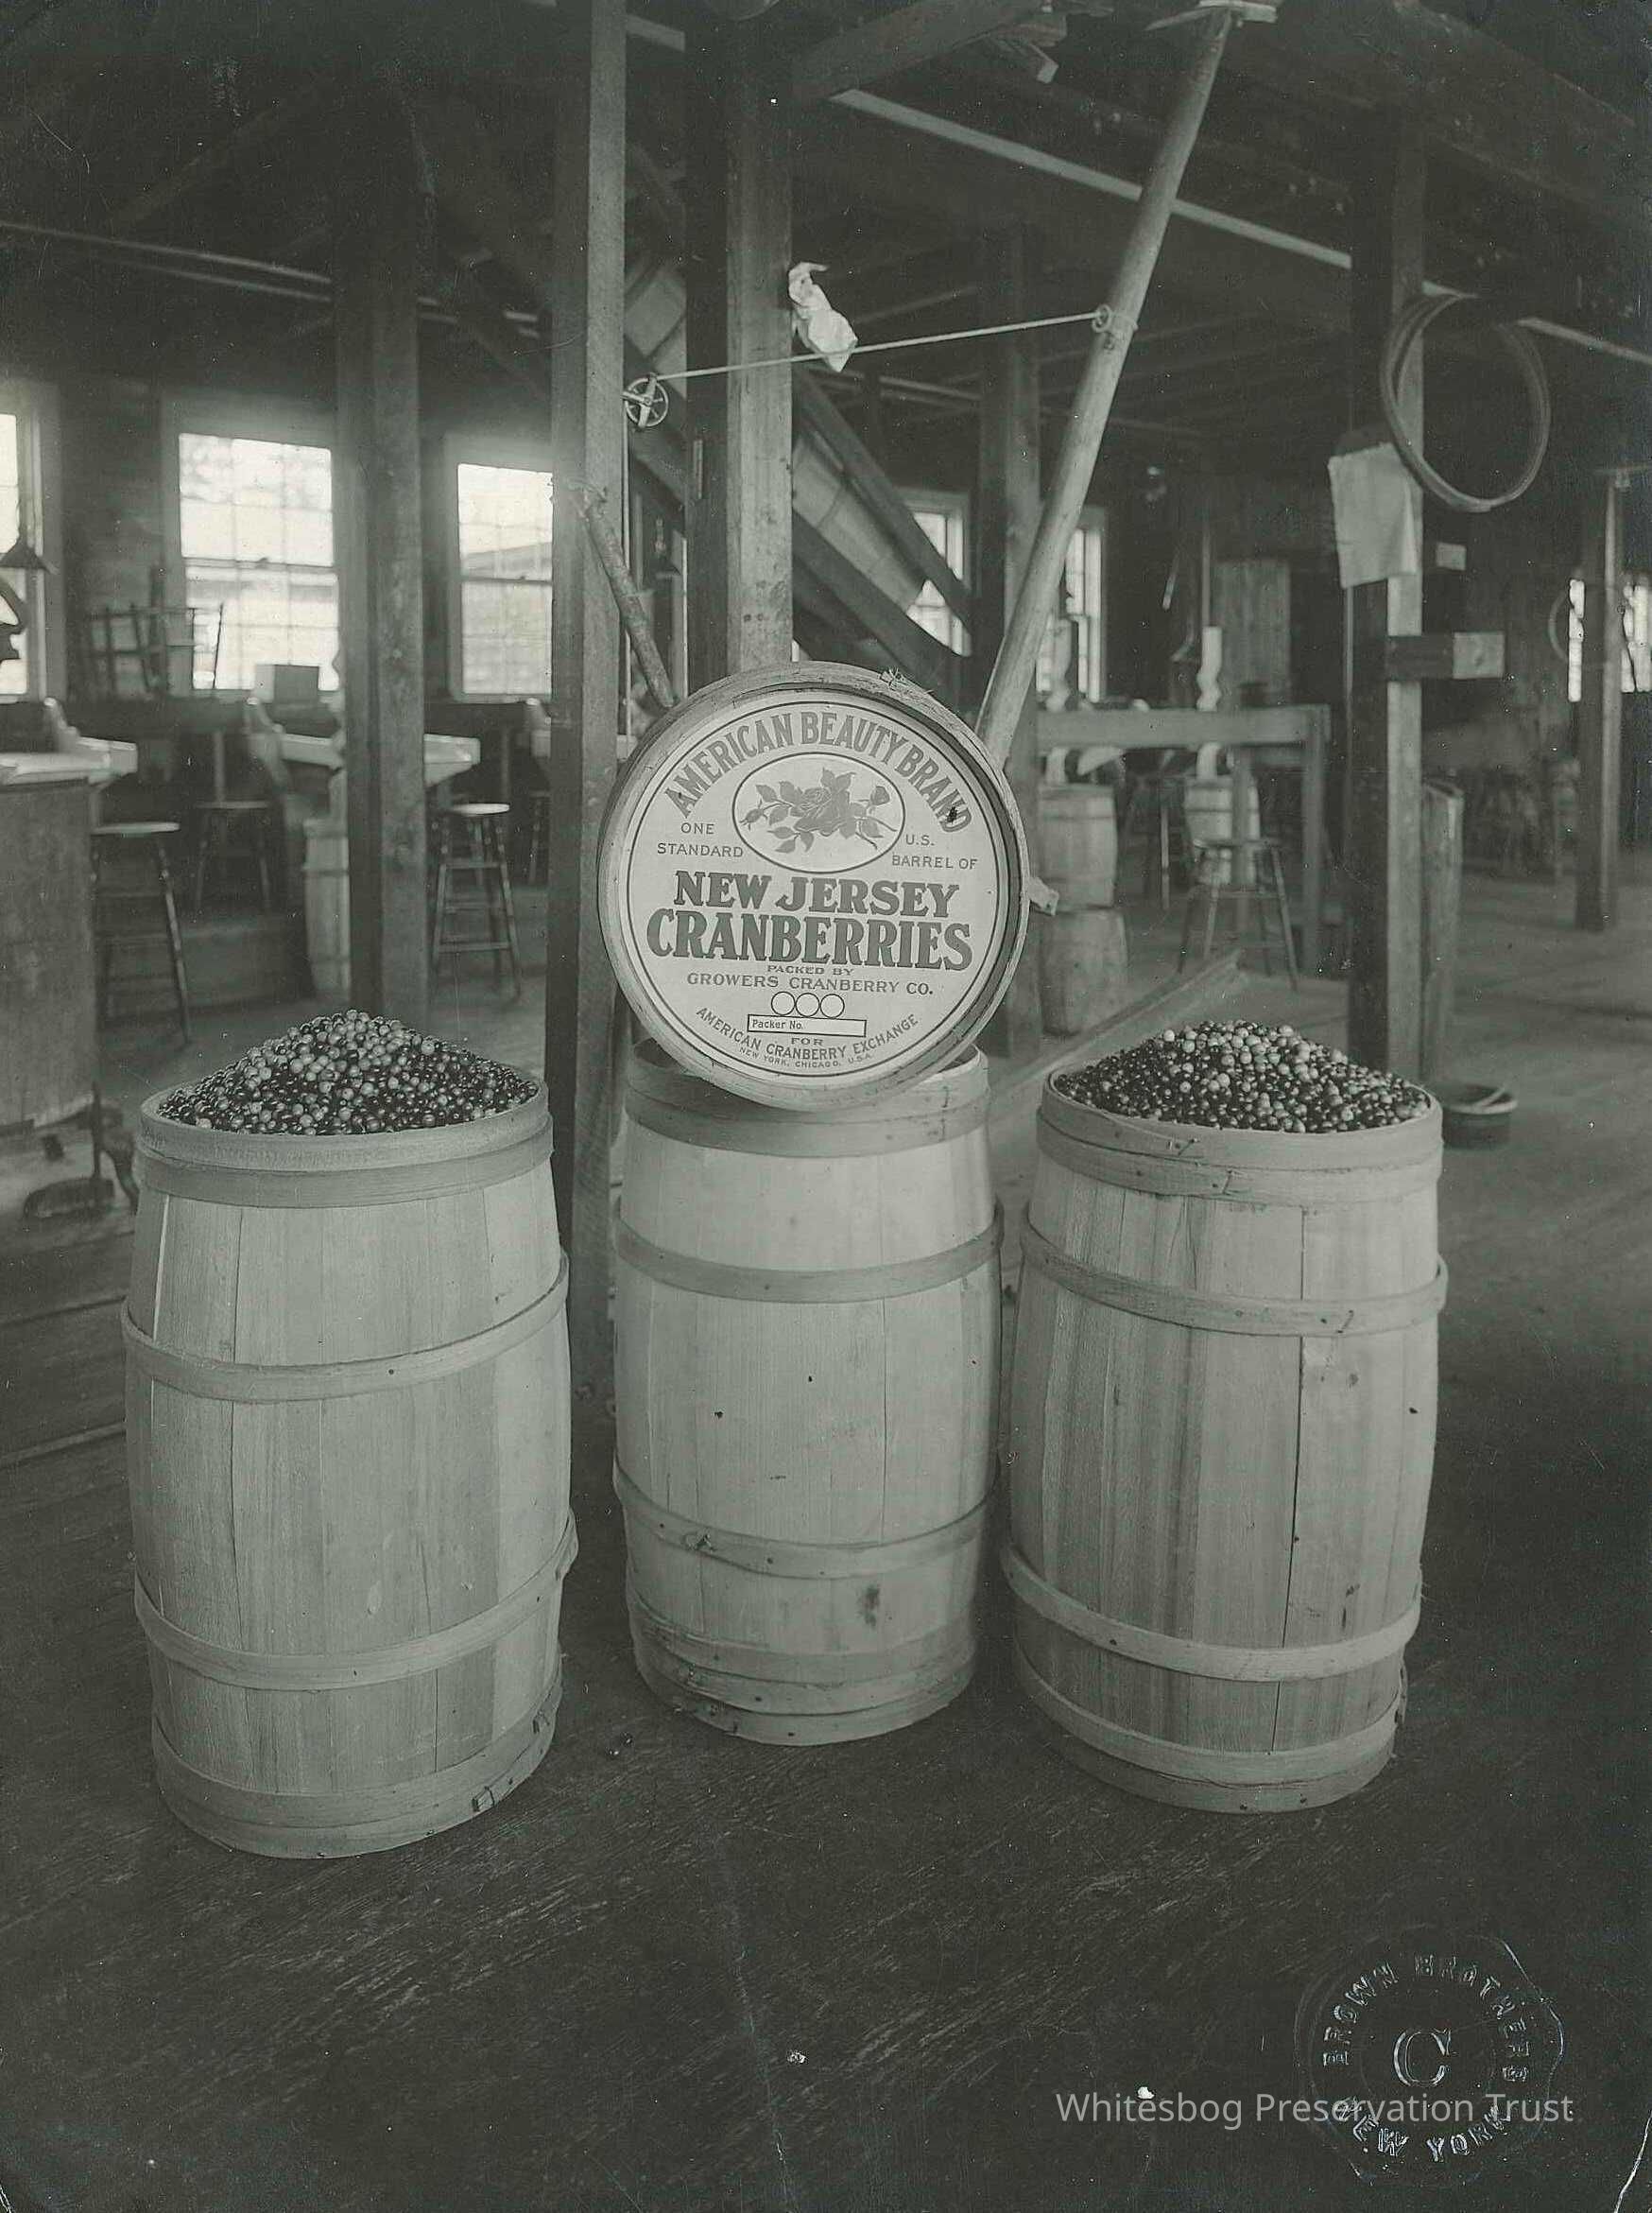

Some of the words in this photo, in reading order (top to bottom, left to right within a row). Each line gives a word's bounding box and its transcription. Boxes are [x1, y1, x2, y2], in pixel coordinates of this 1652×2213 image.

[664, 713, 794, 819] AMERICAN
[800, 711, 910, 766] BEAUTY
[894, 744, 972, 833] BRAND
[680, 822, 714, 835] ONE
[905, 834, 935, 846] U.S.
[657, 842, 744, 857] STANDARD
[891, 855, 954, 869] BARREL
[958, 858, 978, 870] OF
[674, 870, 772, 910] NEW
[775, 877, 959, 918] JERSEY
[646, 908, 973, 972] CRANBERRIES
[767, 965, 825, 976] PACKED
[833, 967, 854, 977] BY
[687, 972, 780, 988] GROWERS
[789, 977, 900, 994] CRANBERRY
[905, 982, 934, 994] CO.
[751, 1019, 786, 1029] Packer
[789, 1020, 804, 1030] No.
[696, 1007, 762, 1050] AMERICAN
[766, 1043, 847, 1061] CRANBERRY
[852, 1013, 920, 1055] EXCHANGE
[791, 1037, 824, 1046] FOR
[739, 1046, 759, 1060] NEW
